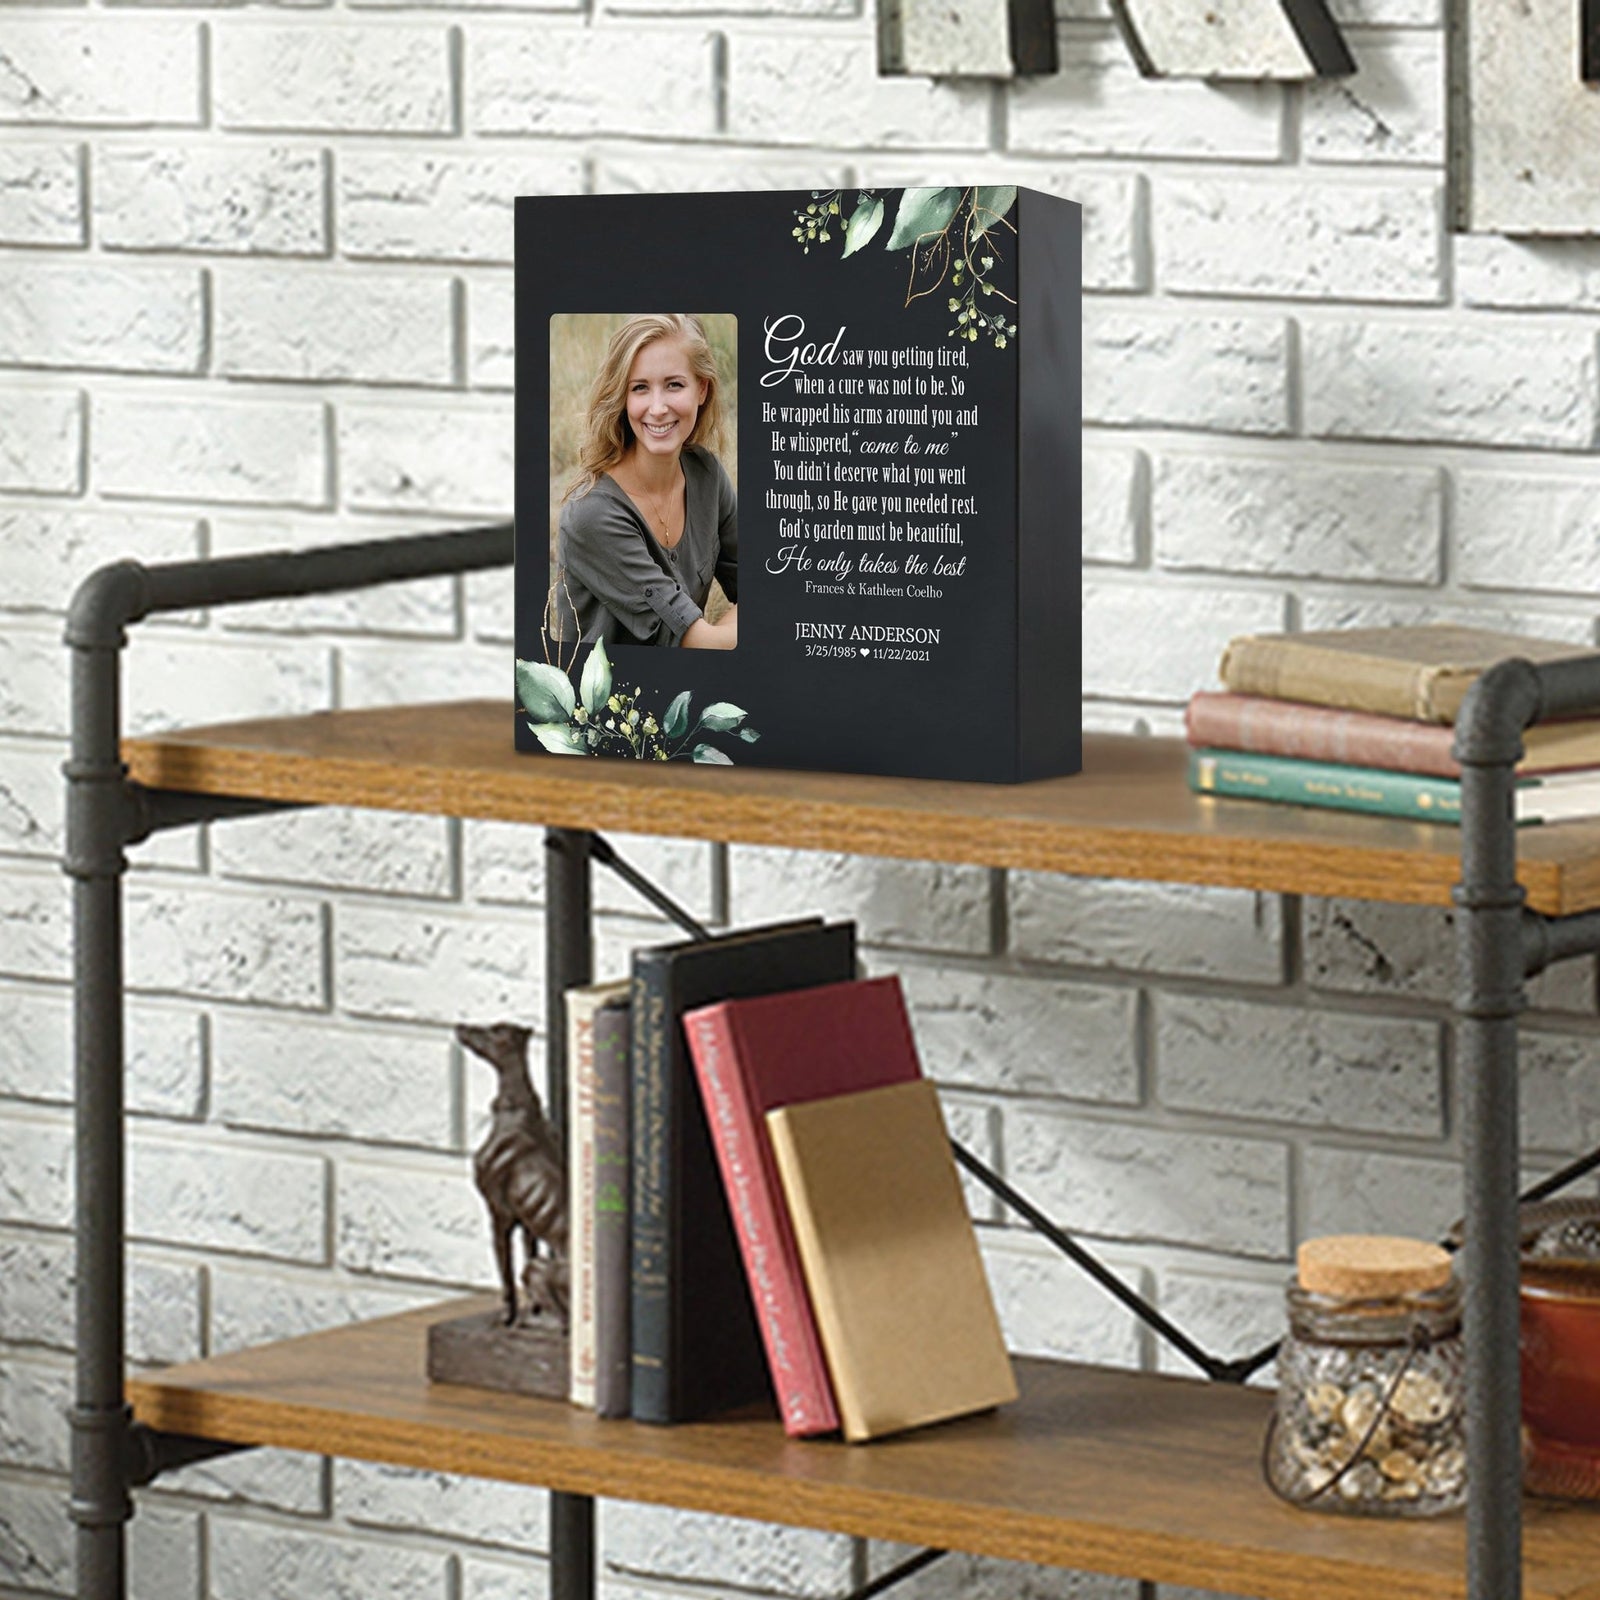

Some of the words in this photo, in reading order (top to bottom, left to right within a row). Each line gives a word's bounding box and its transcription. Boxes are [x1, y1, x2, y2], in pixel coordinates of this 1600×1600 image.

[760, 314, 847, 388] God
[843, 350, 864, 365] saw
[868, 350, 888, 368] you
[892, 346, 933, 369] getting
[938, 346, 969, 368] tired,
[795, 374, 824, 394] when
[828, 379, 835, 394] a
[839, 379, 863, 394] cure
[868, 379, 889, 395] was
[893, 377, 911, 395] not
[916, 377, 926, 395] to
[931, 375, 947, 395] be.
[952, 376, 964, 395] So
[763, 402, 776, 422] He
[780, 403, 829, 426] wrapped
[833, 403, 849, 423] his
[854, 409, 882, 424] arms
[886, 405, 927, 425] around
[932, 410, 952, 428] you
[956, 405, 978, 425] and
[772, 431, 785, 451] He
[904, 434, 921, 454] to
[774, 460, 793, 480] You
[798, 461, 830, 481] didn’t
[834, 462, 878, 482] deserve
[882, 463, 910, 483] what
[914, 468, 934, 486] you
[939, 466, 966, 484] went
[766, 489, 813, 512] through,
[818, 495, 829, 510] so
[834, 491, 848, 510] He
[852, 496, 877, 514] gave
[881, 497, 901, 515] you
[906, 493, 947, 513] needed
[952, 496, 977, 514] rest.
[780, 518, 809, 538] God’s
[814, 520, 853, 542] garden
[858, 523, 885, 541] must
[890, 521, 903, 541] be
[907, 522, 963, 546] beautiful,
[766, 544, 812, 574] He
[817, 551, 853, 581] only
[859, 553, 899, 573] takes
[905, 554, 928, 575] the
[932, 555, 966, 576] best
[806, 580, 844, 594] Frances
[847, 583, 855, 594] &
[859, 583, 903, 596] Kathleen
[907, 585, 942, 598] Coelho
[796, 623, 846, 640] JENNY
[849, 625, 940, 644] ANDERSON
[806, 644, 856, 658] 3/25/1985
[874, 648, 929, 661] 11/22/2021
